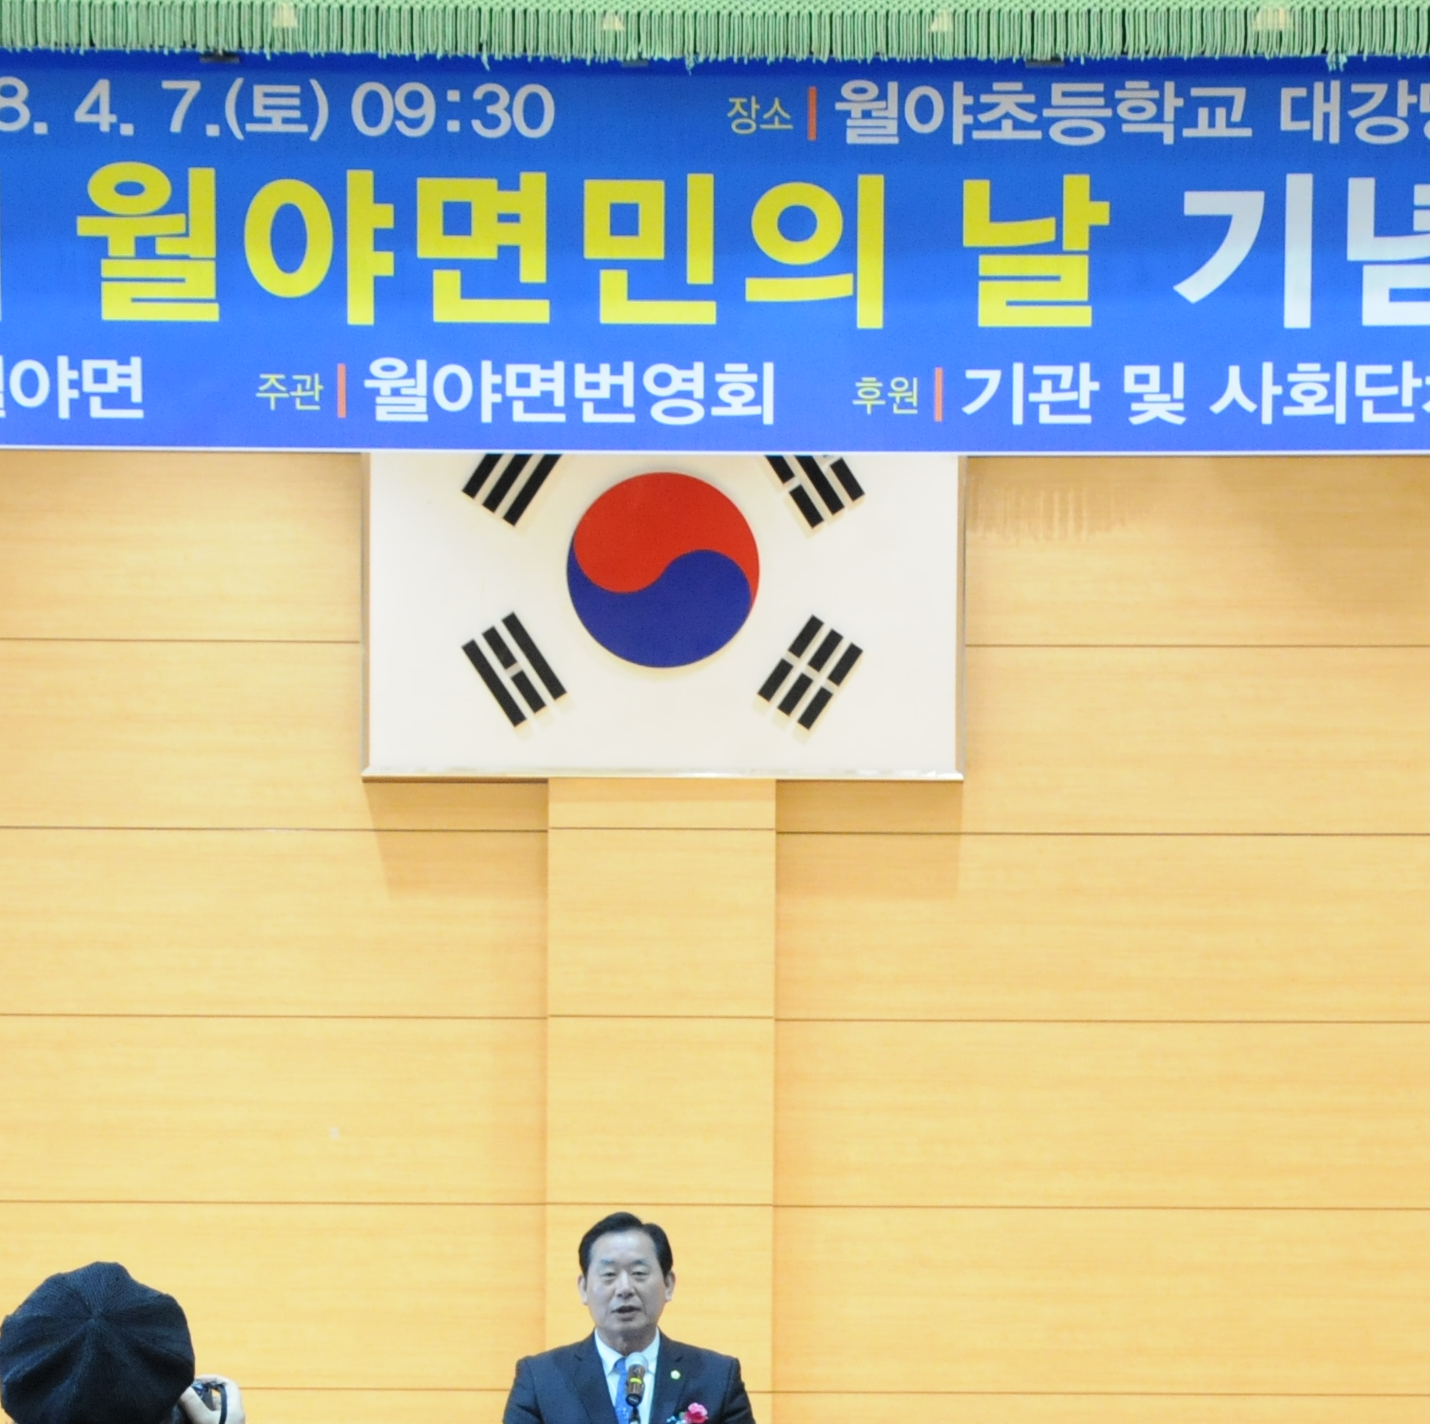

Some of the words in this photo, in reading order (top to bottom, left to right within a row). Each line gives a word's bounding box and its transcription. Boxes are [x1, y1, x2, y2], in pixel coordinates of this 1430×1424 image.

[74, 79, 135, 136] 4.
[162, 78, 330, 141] 7.(토)
[351, 82, 556, 138] 09:30
[727, 96, 794, 135] 장소
[835, 79, 1253, 145] 월야초등학교
[76, 160, 885, 330] 월야면민의
[962, 173, 1110, 328] 날
[255, 372, 324, 411] 주관
[363, 356, 775, 426] 월야면번영회
[852, 376, 919, 415] 후원
[961, 361, 1094, 426] 기관
[1123, 361, 1187, 426] 및
